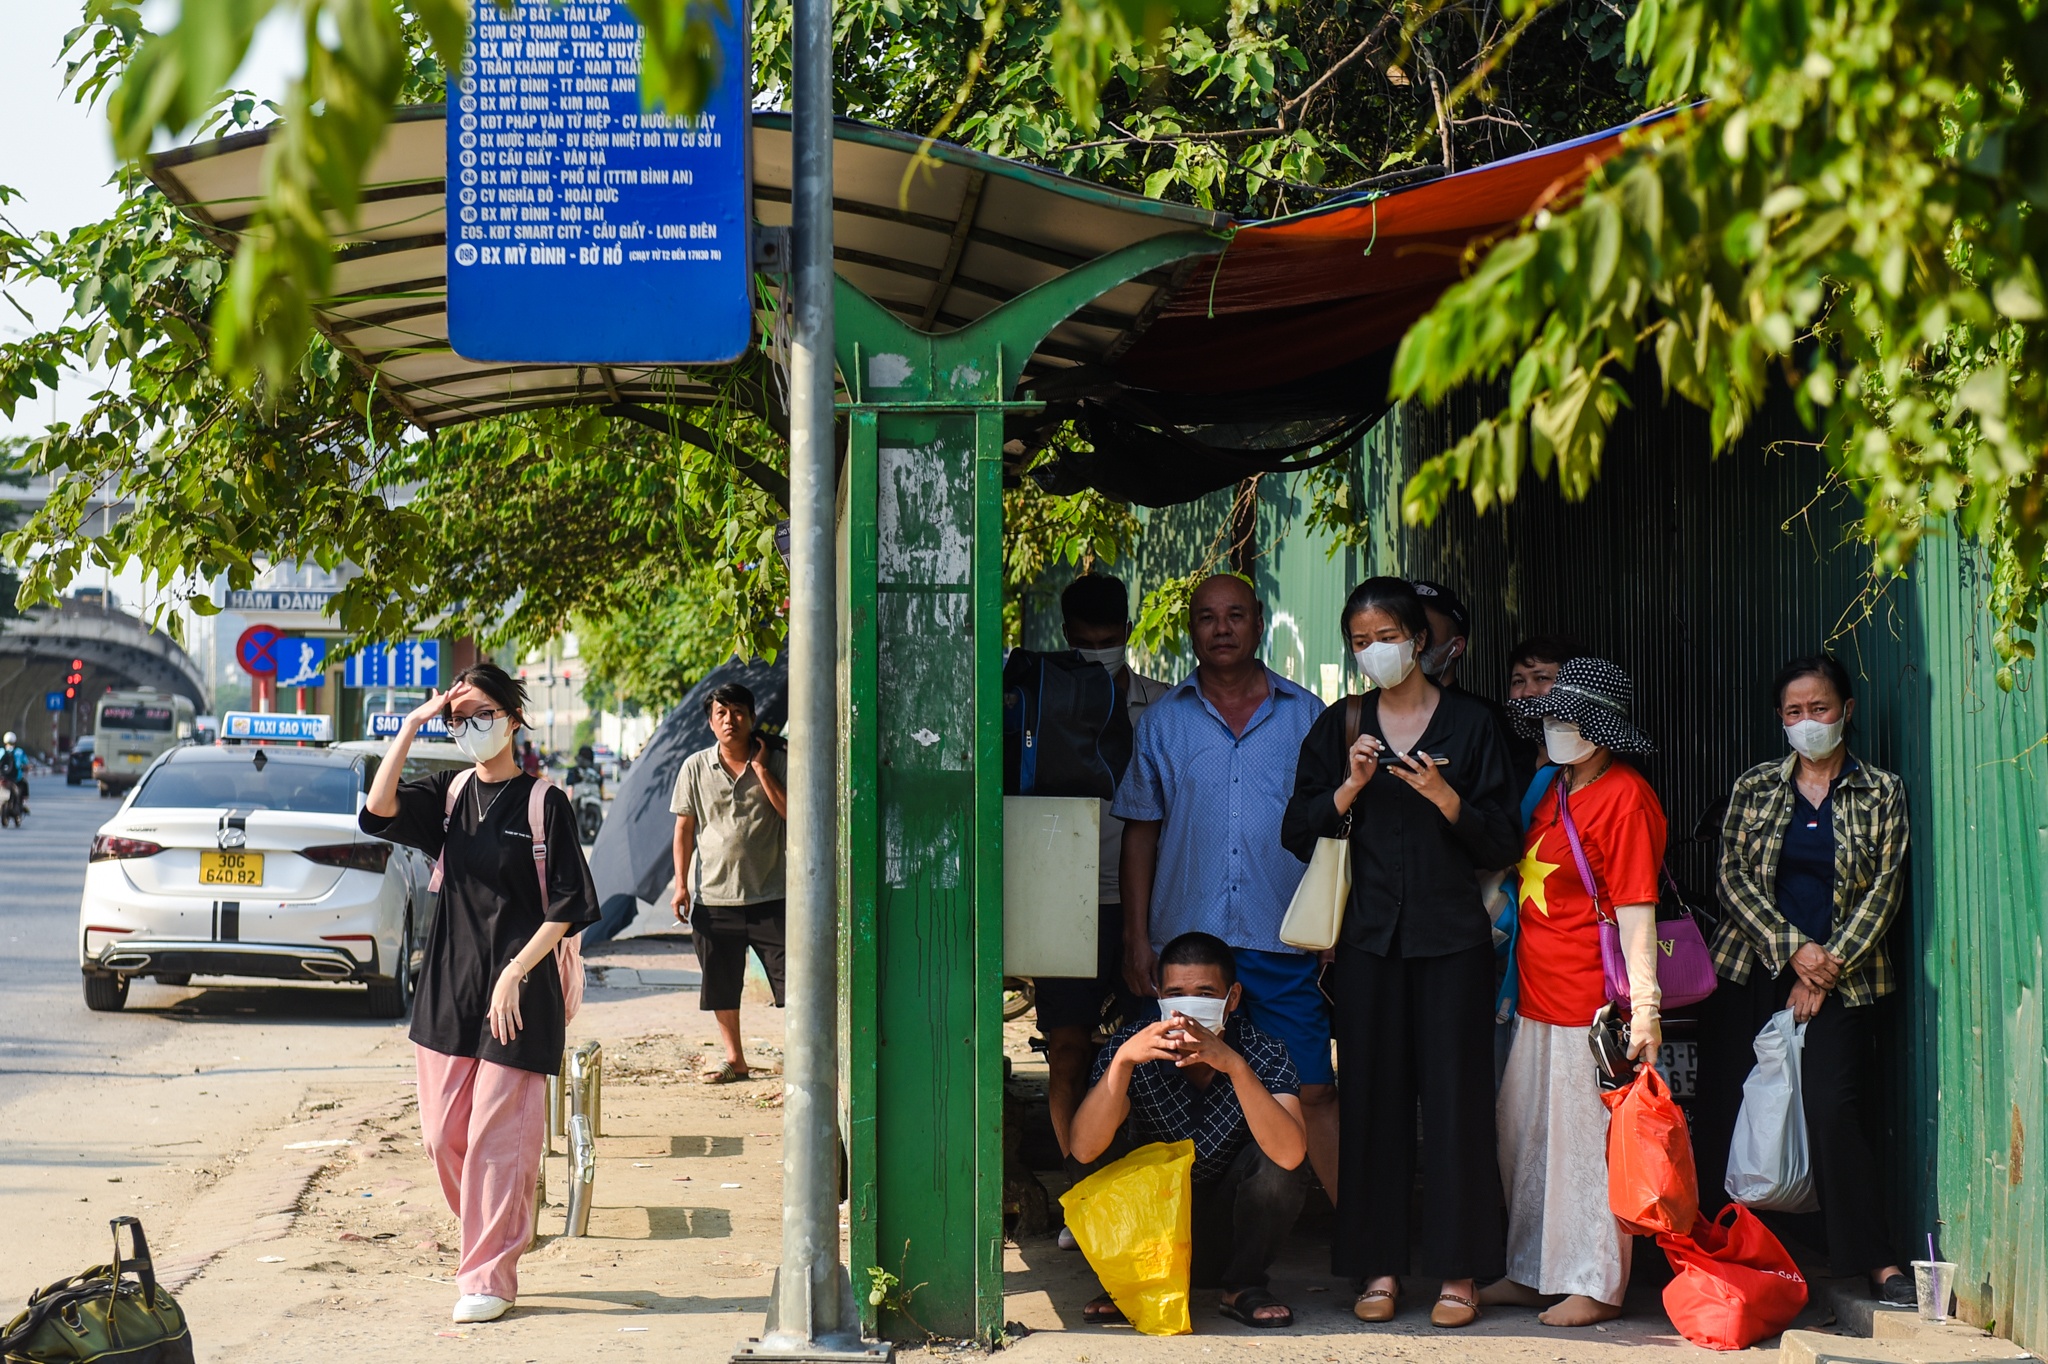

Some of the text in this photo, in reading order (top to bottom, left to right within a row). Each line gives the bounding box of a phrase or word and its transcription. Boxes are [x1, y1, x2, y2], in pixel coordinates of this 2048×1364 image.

[480, 7, 496, 22] BX
[563, 4, 586, 22] TÂN
[589, 4, 611, 24] LẬP
[480, 24, 507, 41] CỤM
[509, 24, 526, 39] CN
[529, 24, 568, 39] THANH
[570, 24, 591, 39] OAI
[602, 22, 634, 39] XUÂN
[480, 41, 498, 58] BX
[501, 38, 523, 58] MỸ
[526, 38, 559, 58] ĐÌNH
[571, 42, 605, 58] TTHC
[514, 58, 555, 75] KHÁNH
[557, 59, 575, 75] DƯ
[584, 60, 612, 75] NAM
[614, 59, 646, 75] THĂN
[480, 78, 496, 93] BX
[499, 76, 517, 93] MỸ
[520, 75, 549, 93] ĐÌNH
[559, 78, 573, 93] TT
[575, 76, 608, 93] ĐÔNG
[611, 78, 636, 93] ANH
[480, 96, 496, 111] BX
[499, 94, 517, 111] MỸ
[520, 93, 549, 111] ĐÌNH
[559, 96, 583, 111] KIM
[586, 96, 610, 111] HOA
[480, 114, 503, 129] KĐT
[505, 112, 537, 129] PHÁP
[540, 112, 564, 129] VÂN
[584, 112, 611, 131] HIỆP
[622, 114, 638, 129] CV
[480, 133, 495, 147] BX
[496, 130, 525, 147] NƯỚC
[566, 133, 580, 147] BV
[582, 131, 609, 149] BỆNH
[612, 131, 641, 150] NHIỆT
[663, 133, 679, 147] TW
[713, 133, 721, 147] II
[463, 154, 473, 163] 61
[480, 151, 496, 166] CV
[563, 149, 587, 166] VÂN
[590, 148, 606, 166] HÀ
[463, 171, 474, 182] 64
[481, 170, 497, 184] BX
[500, 167, 518, 184] MỸ
[521, 166, 550, 184] ĐÌNH
[603, 170, 638, 185] (TTTM
[640, 166, 669, 184] BÌNH
[672, 170, 693, 186] AN)
[462, 191, 474, 201] 97
[480, 188, 496, 203] CV
[498, 186, 535, 203] NGHĨA
[537, 185, 554, 203] ĐÔ
[564, 185, 592, 203] HOÀI
[481, 207, 497, 221] BX
[500, 204, 518, 221] MỸ
[521, 203, 550, 221] ĐÌNH
[560, 204, 581, 223] NỘI
[584, 203, 604, 221] BÀI
[461, 225, 487, 239] E05.
[489, 225, 512, 239] KĐT
[514, 225, 555, 239] SMART
[557, 225, 582, 239] CITY
[656, 225, 687, 239] LONG
[689, 221, 717, 239] BIÊN
[481, 246, 501, 265] BX
[504, 243, 528, 265] MỸ
[530, 242, 566, 265] ĐÌNH
[579, 242, 600, 265] BỜ
[254, 720, 276, 735] TAXI
[279, 721, 299, 735] SAO
[376, 717, 399, 731] SAO
[218, 855, 245, 868] 30G
[206, 869, 256, 884] 640.82
